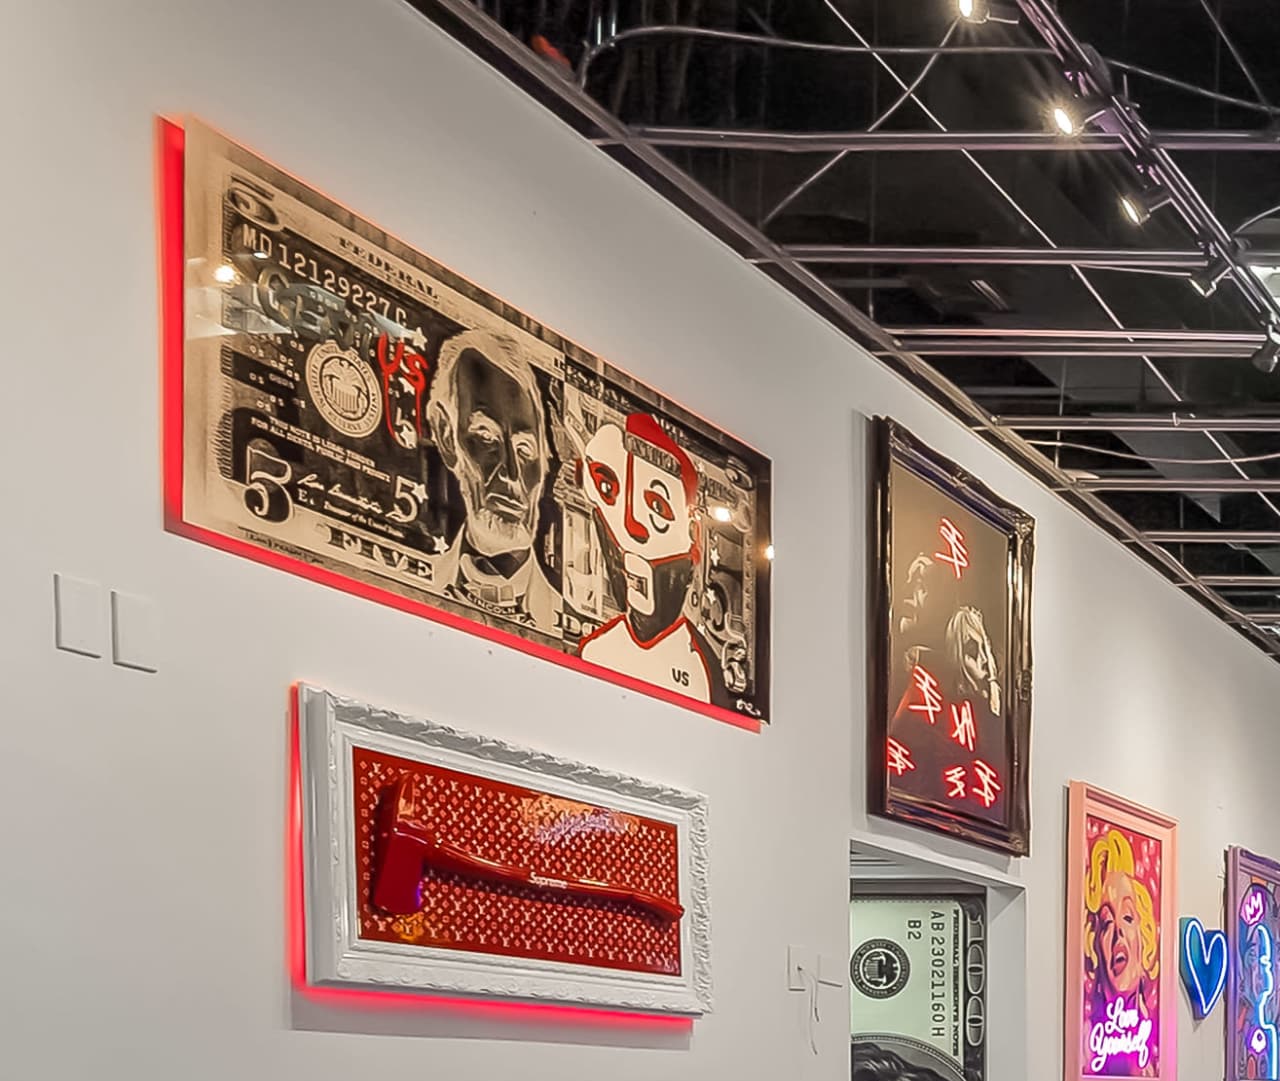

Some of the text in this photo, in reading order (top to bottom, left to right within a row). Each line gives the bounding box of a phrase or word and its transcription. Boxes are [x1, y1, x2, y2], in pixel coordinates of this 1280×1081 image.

[338, 237, 440, 301] FEDERAL
[244, 445, 294, 524] 5
[326, 524, 433, 583] FIVE
[465, 591, 516, 615] LINCOLN
[671, 667, 690, 687] US
[528, 871, 568, 889] Supreme
[907, 919, 922, 940] B2
[930, 936, 946, 1023] 23021160
